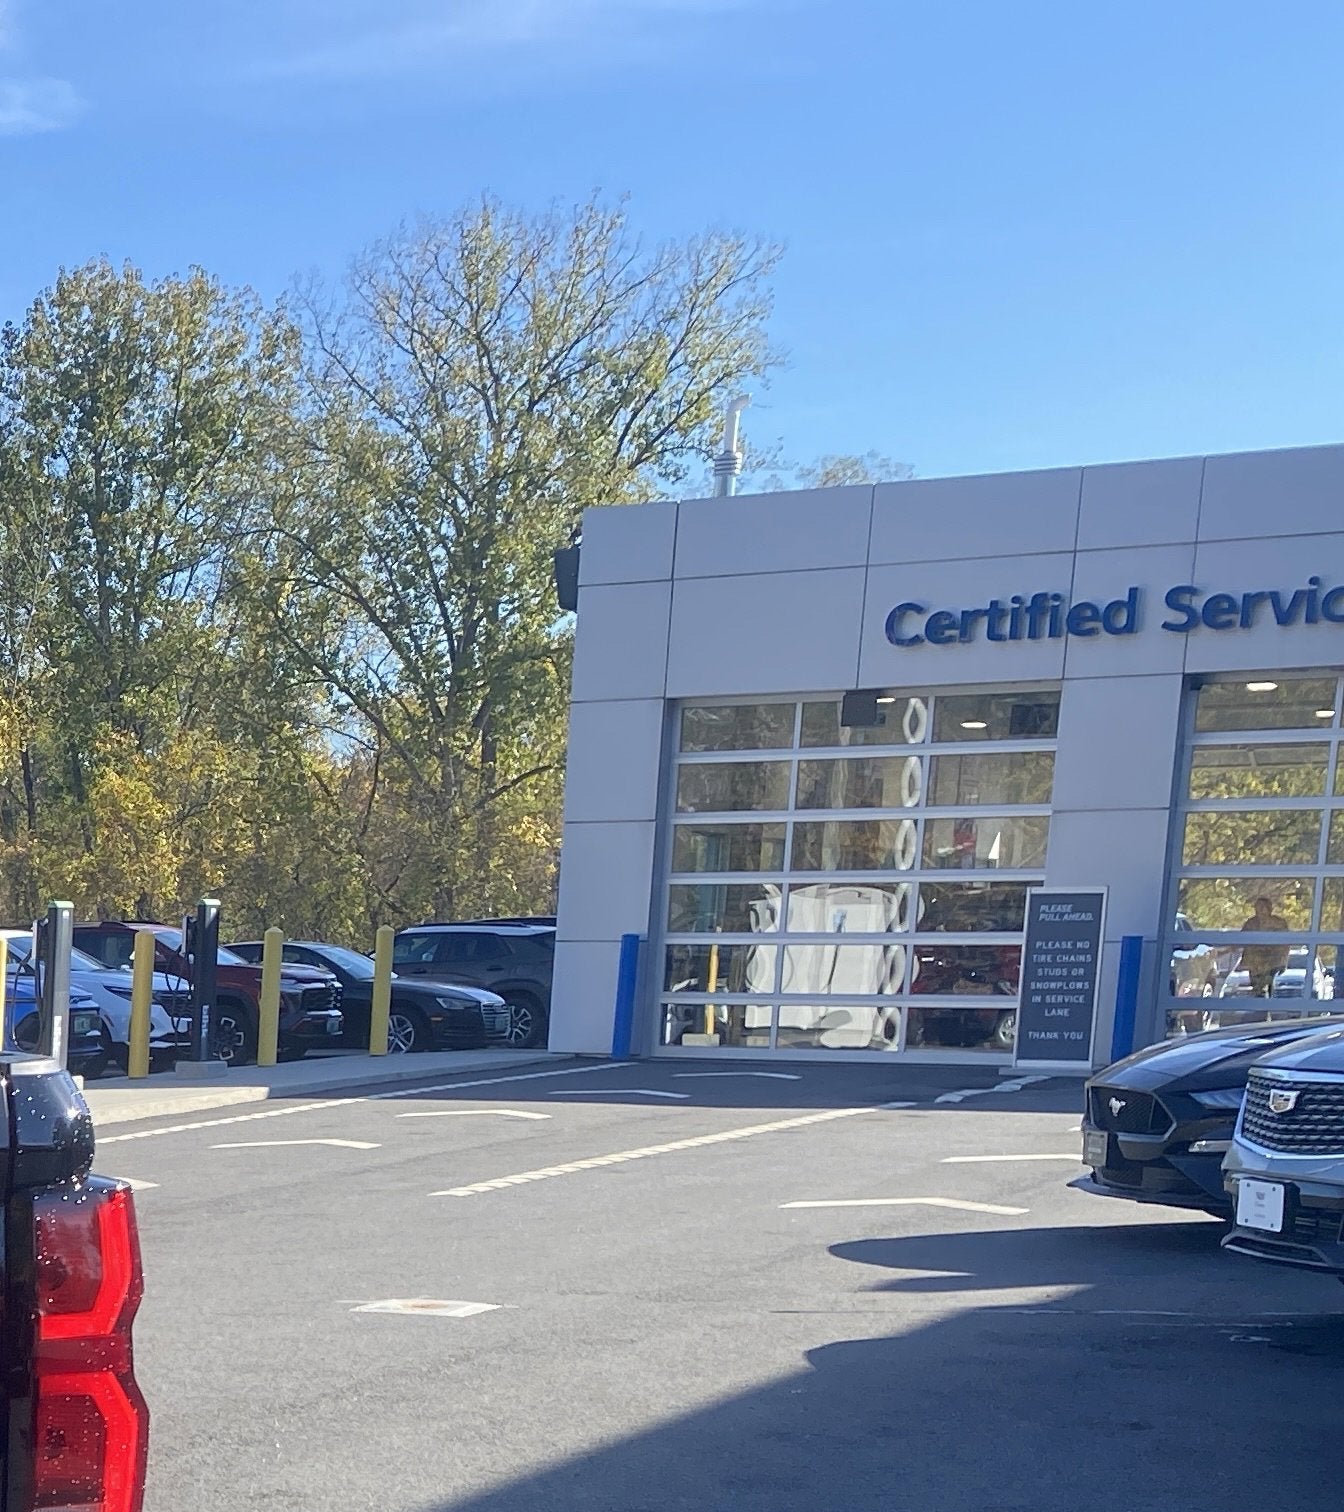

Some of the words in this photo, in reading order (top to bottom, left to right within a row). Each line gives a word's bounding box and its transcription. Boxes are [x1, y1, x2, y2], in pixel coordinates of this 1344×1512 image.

[885, 587, 1138, 648] Certified
[1040, 904, 1073, 913] PLEASE
[1038, 913, 1061, 921] PULL
[1062, 912, 1094, 921] AHEAD.
[1036, 941, 1073, 949] PLEASE
[1076, 941, 1090, 949] NO
[1032, 954, 1053, 963] TIRE
[1056, 954, 1092, 963] CHAINS
[1037, 968, 1068, 977] STUDS
[1071, 968, 1085, 976] OR
[1030, 981, 1090, 990] SNOWPLOWS
[1031, 994, 1042, 1003] IN
[1045, 994, 1085, 1003] SERVICE
[1044, 1008, 1070, 1017] LANE
[1028, 1031, 1059, 1040] THANK
[1063, 1031, 1084, 1040] YOU
